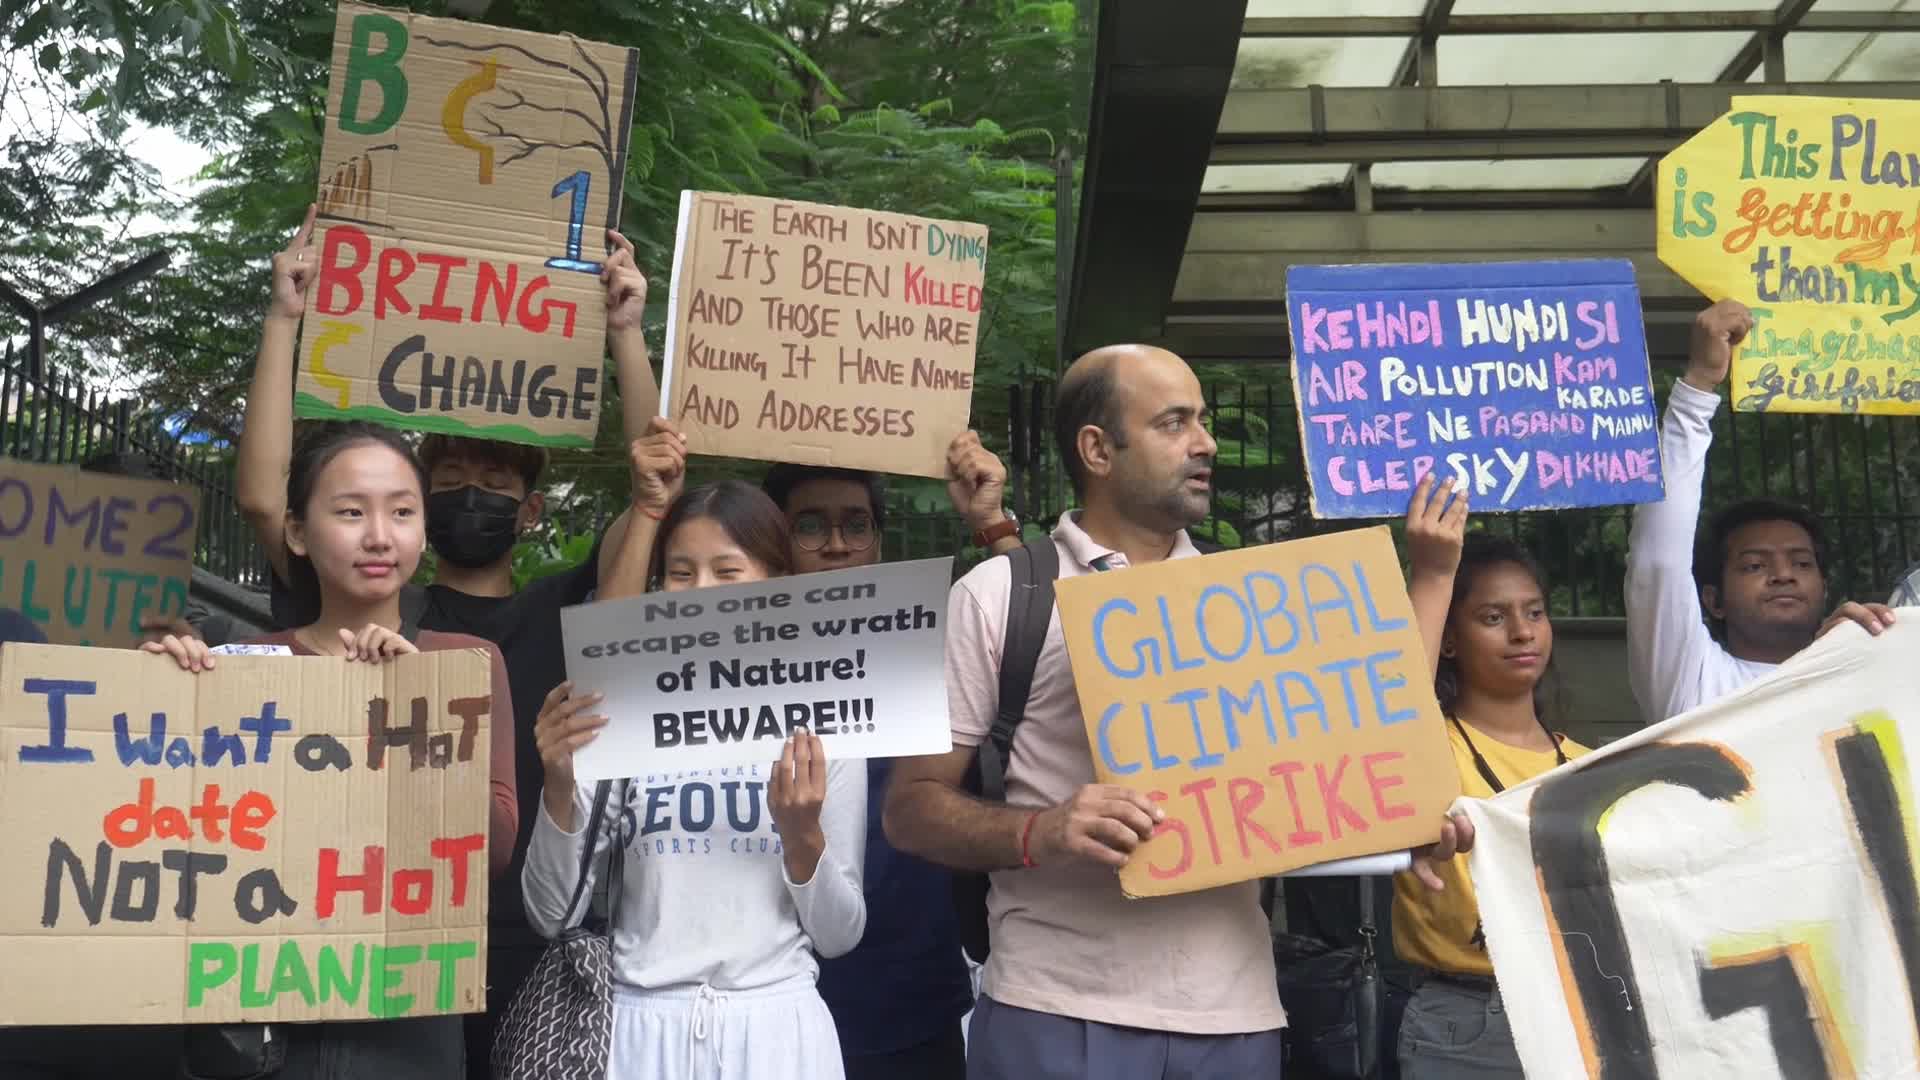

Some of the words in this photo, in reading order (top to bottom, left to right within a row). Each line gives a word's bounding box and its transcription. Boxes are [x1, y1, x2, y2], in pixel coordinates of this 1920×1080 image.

[337, 13, 409, 136] B
[1728, 111, 1822, 181] This
[543, 170, 605, 275] 1
[700, 198, 755, 234] THE
[773, 203, 848, 243] EARTH
[868, 217, 922, 250] ISN'T
[927, 223, 986, 271] DYING
[1672, 167, 1717, 239] is
[315, 225, 577, 339] BRING
[801, 244, 890, 298] BEEN
[903, 262, 982, 312] KILLED
[1750, 245, 1848, 304] than
[688, 288, 743, 327] AND
[760, 297, 841, 339] THOSE
[856, 309, 915, 341] WHO
[924, 314, 972, 346] ARE
[1301, 299, 1443, 354] KEHNDI
[1457, 298, 1569, 353] HUNDI
[1575, 301, 1621, 351] SI
[378, 334, 598, 421] CHANGE
[687, 333, 768, 381] KILLING
[839, 346, 905, 386] HAVE
[910, 357, 973, 391] NAME
[1308, 360, 1368, 406] AIR
[1379, 356, 1549, 402] POLLUTION
[1554, 352, 1618, 387] KAM
[679, 384, 740, 430] AND
[757, 390, 916, 438] ADDRESSES
[1310, 411, 1418, 449] TAARE
[1479, 406, 1587, 438] PASAND
[1591, 413, 1654, 441] MAINU
[1556, 385, 1646, 410] KARADE
[1446, 448, 1529, 505] SKY
[1536, 447, 1661, 490] DIKHADE
[143, 494, 195, 561] 2
[0, 557, 188, 638] LUTED
[644, 600, 704, 623] No
[716, 590, 793, 615] one
[804, 580, 877, 605] can
[1092, 560, 1409, 680] GLOBAL
[581, 627, 721, 660] escape
[733, 620, 800, 645] the
[811, 604, 937, 635] wrath
[655, 660, 697, 694] of
[709, 648, 867, 690] Nature!
[18, 678, 97, 764] I
[294, 733, 353, 772] a
[652, 697, 876, 749] BEWARE!!!
[1096, 650, 1419, 776] CLIMATE
[103, 777, 277, 851] date
[730, 837, 782, 855] CLUB
[1146, 752, 1416, 881] STRIKE
[233, 868, 299, 924] a
[187, 939, 477, 1020] PLANET
